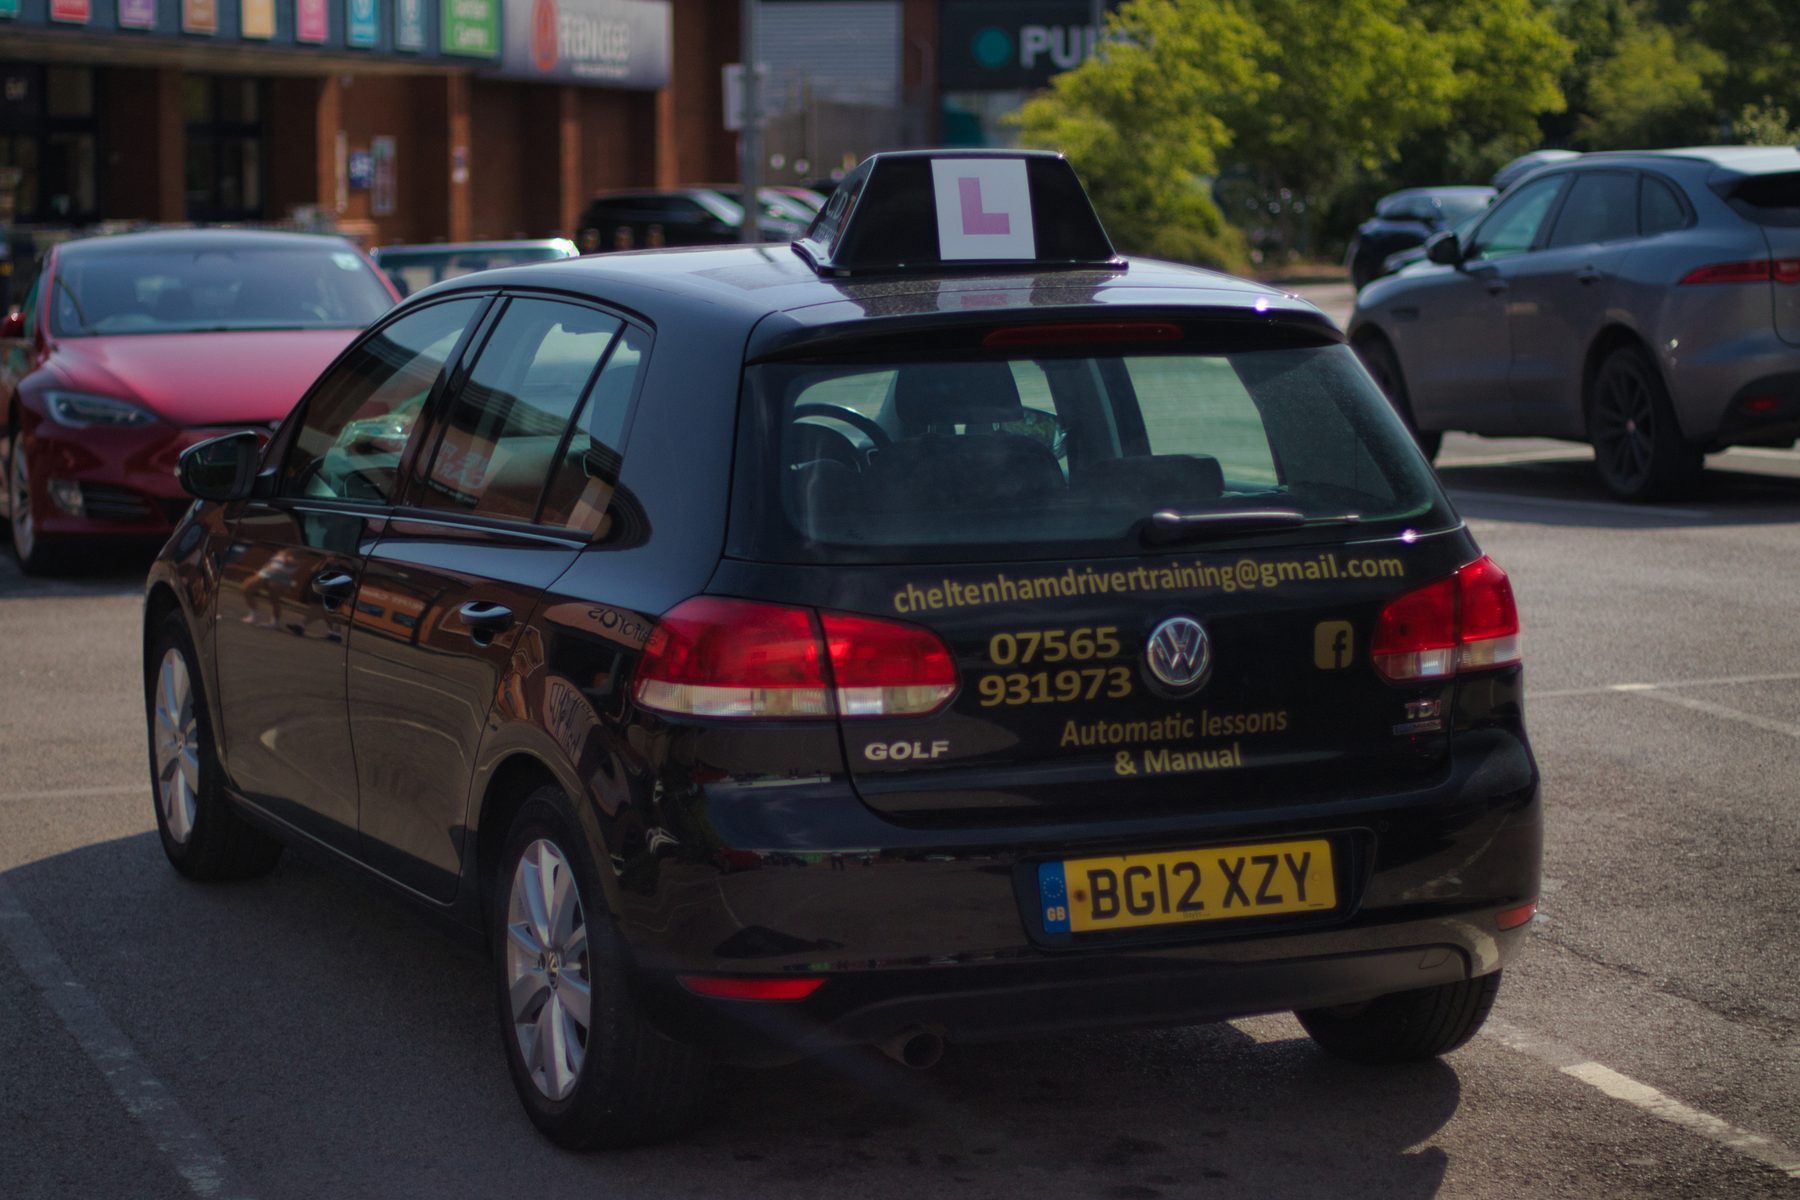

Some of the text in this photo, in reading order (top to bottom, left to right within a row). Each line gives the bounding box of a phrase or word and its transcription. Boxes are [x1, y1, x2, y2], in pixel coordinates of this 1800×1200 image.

[958, 176, 1011, 235] L
[893, 553, 1405, 614] cheltenhamdrivertraining@gmail.com
[989, 626, 1121, 667] 07565
[979, 666, 1133, 707] 931973
[1060, 707, 1288, 748] Automatic lessons
[864, 739, 950, 762] GOLF
[1114, 743, 1242, 776] & Manual
[1086, 851, 1313, 921] BG12 XZY
[1046, 905, 1067, 922] GB
